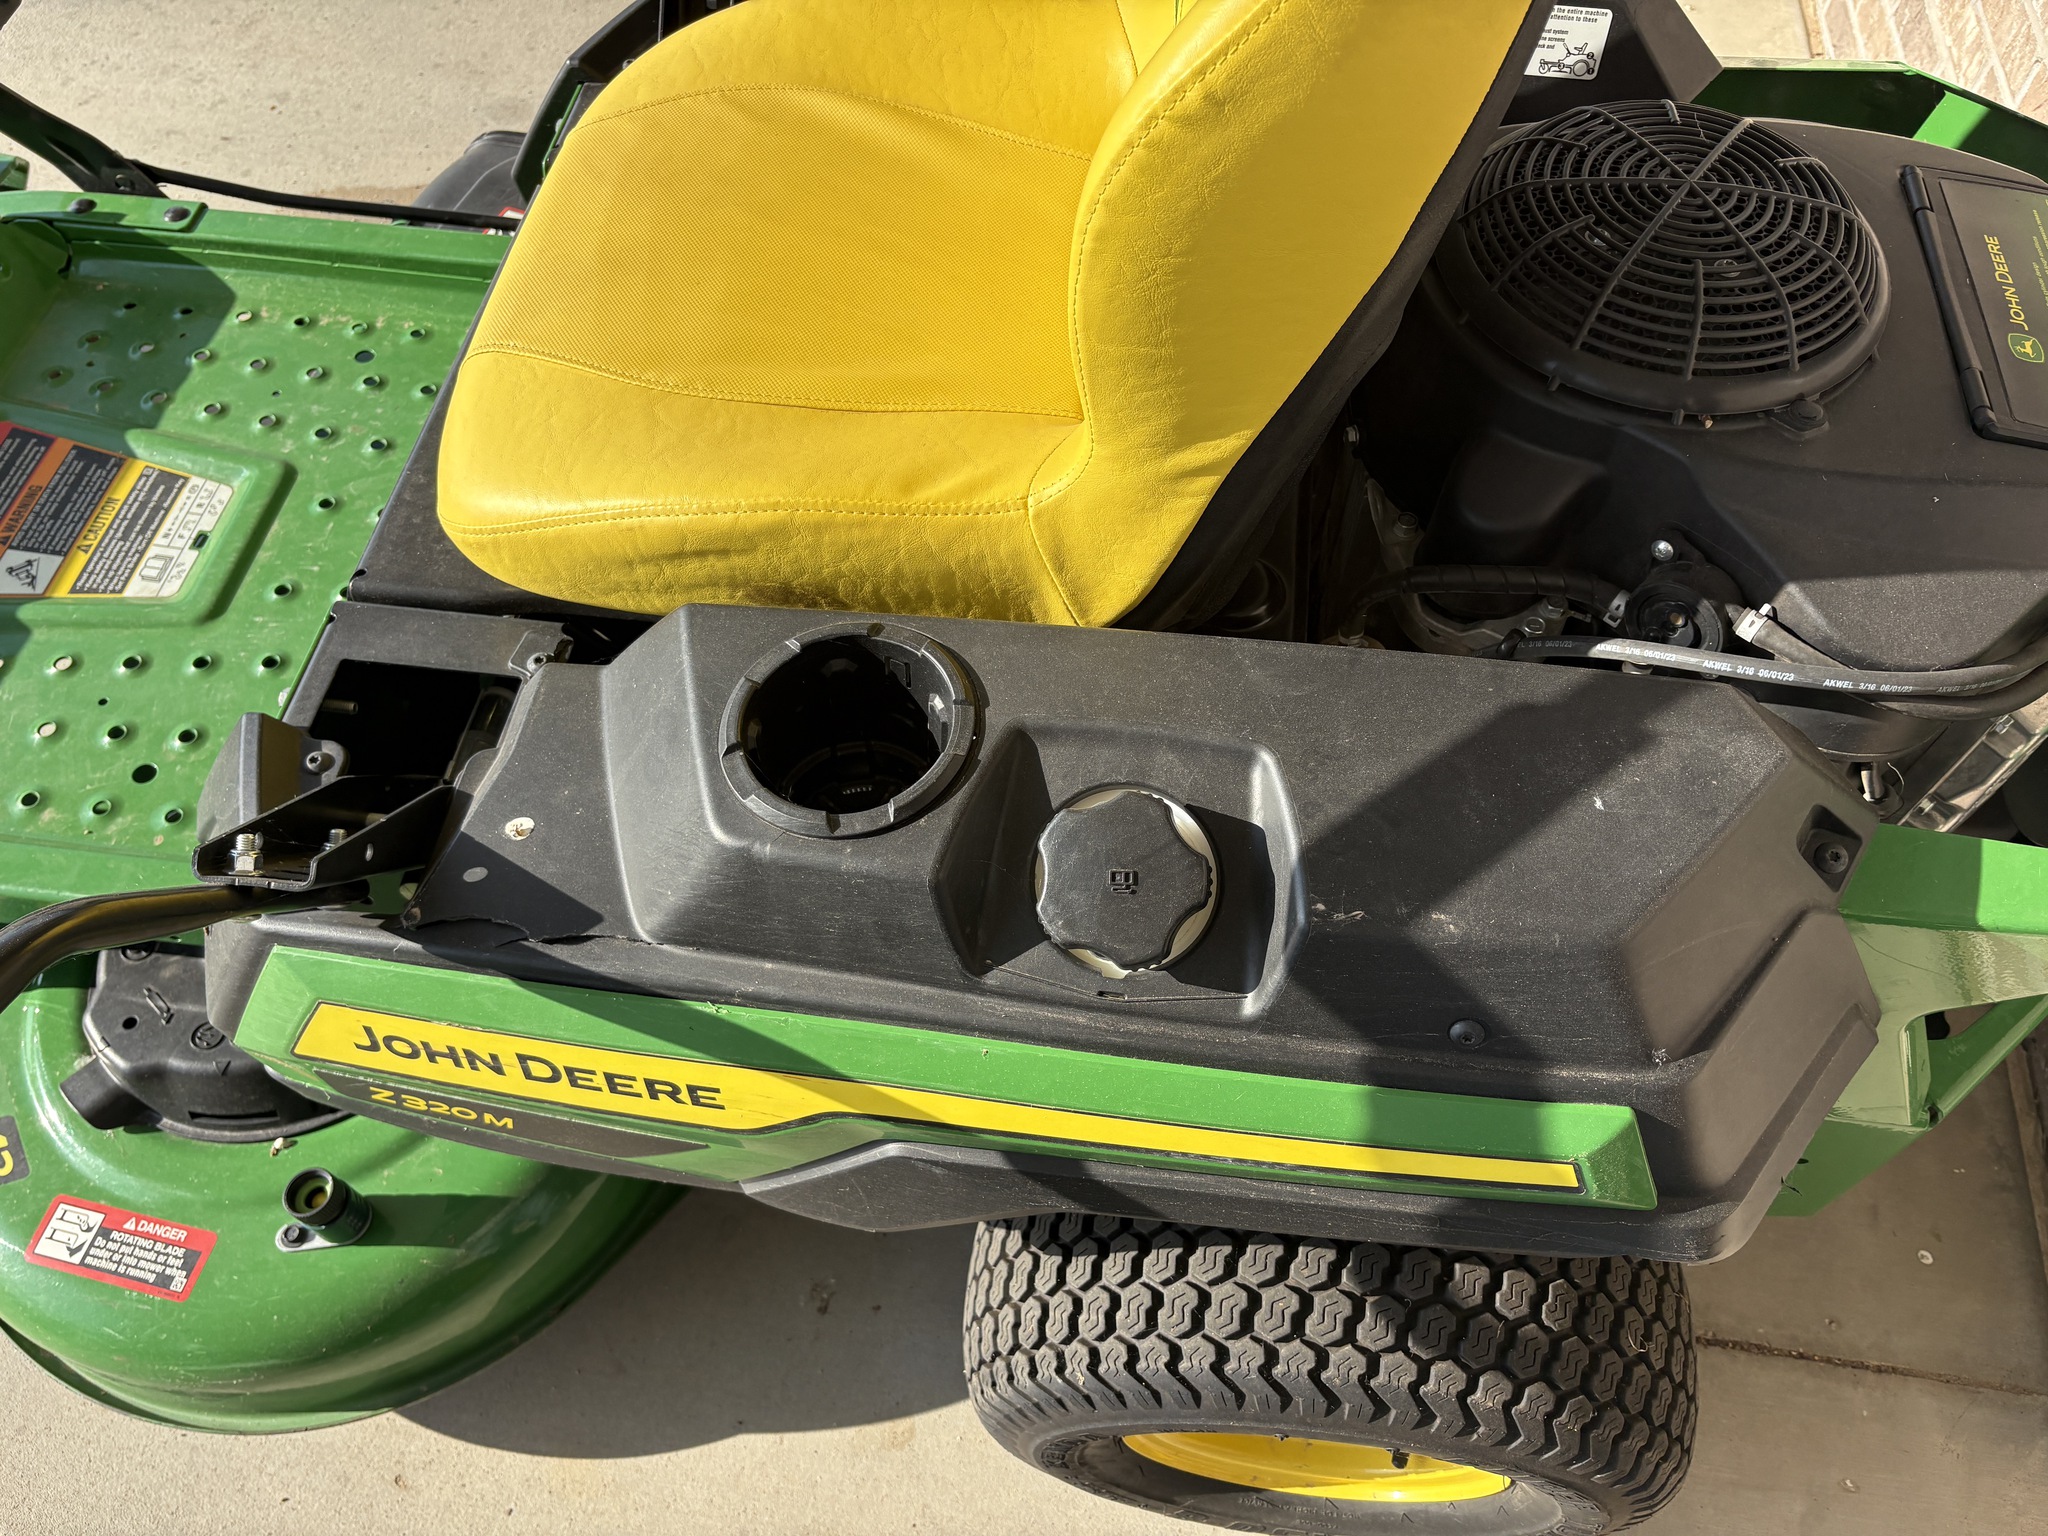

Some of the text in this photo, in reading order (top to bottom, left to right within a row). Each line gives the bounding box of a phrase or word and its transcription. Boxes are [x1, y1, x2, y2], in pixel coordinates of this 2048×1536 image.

[1585, 9, 1608, 17] machine
[1984, 234, 2029, 330] JOHN DEERE
[4, 486, 42, 533] WARNING
[86, 497, 122, 542] CAUTION
[1596, 644, 1676, 662] AKWEL 3/16 06/01/23
[1703, 660, 1795, 682] AKWEL 3/16 06/01/23
[1823, 679, 1913, 692] AKWEL 3/16 06/01/23
[354, 1025, 726, 1110] JOHN DEERE
[110, 1230, 186, 1258] ROTATING BLADE
[137, 1220, 188, 1242] DANGER
[89, 1247, 187, 1278] under or into mower when
[94, 1236, 184, 1268] Do not put hands or feet
[84, 1256, 156, 1283] machine is running
